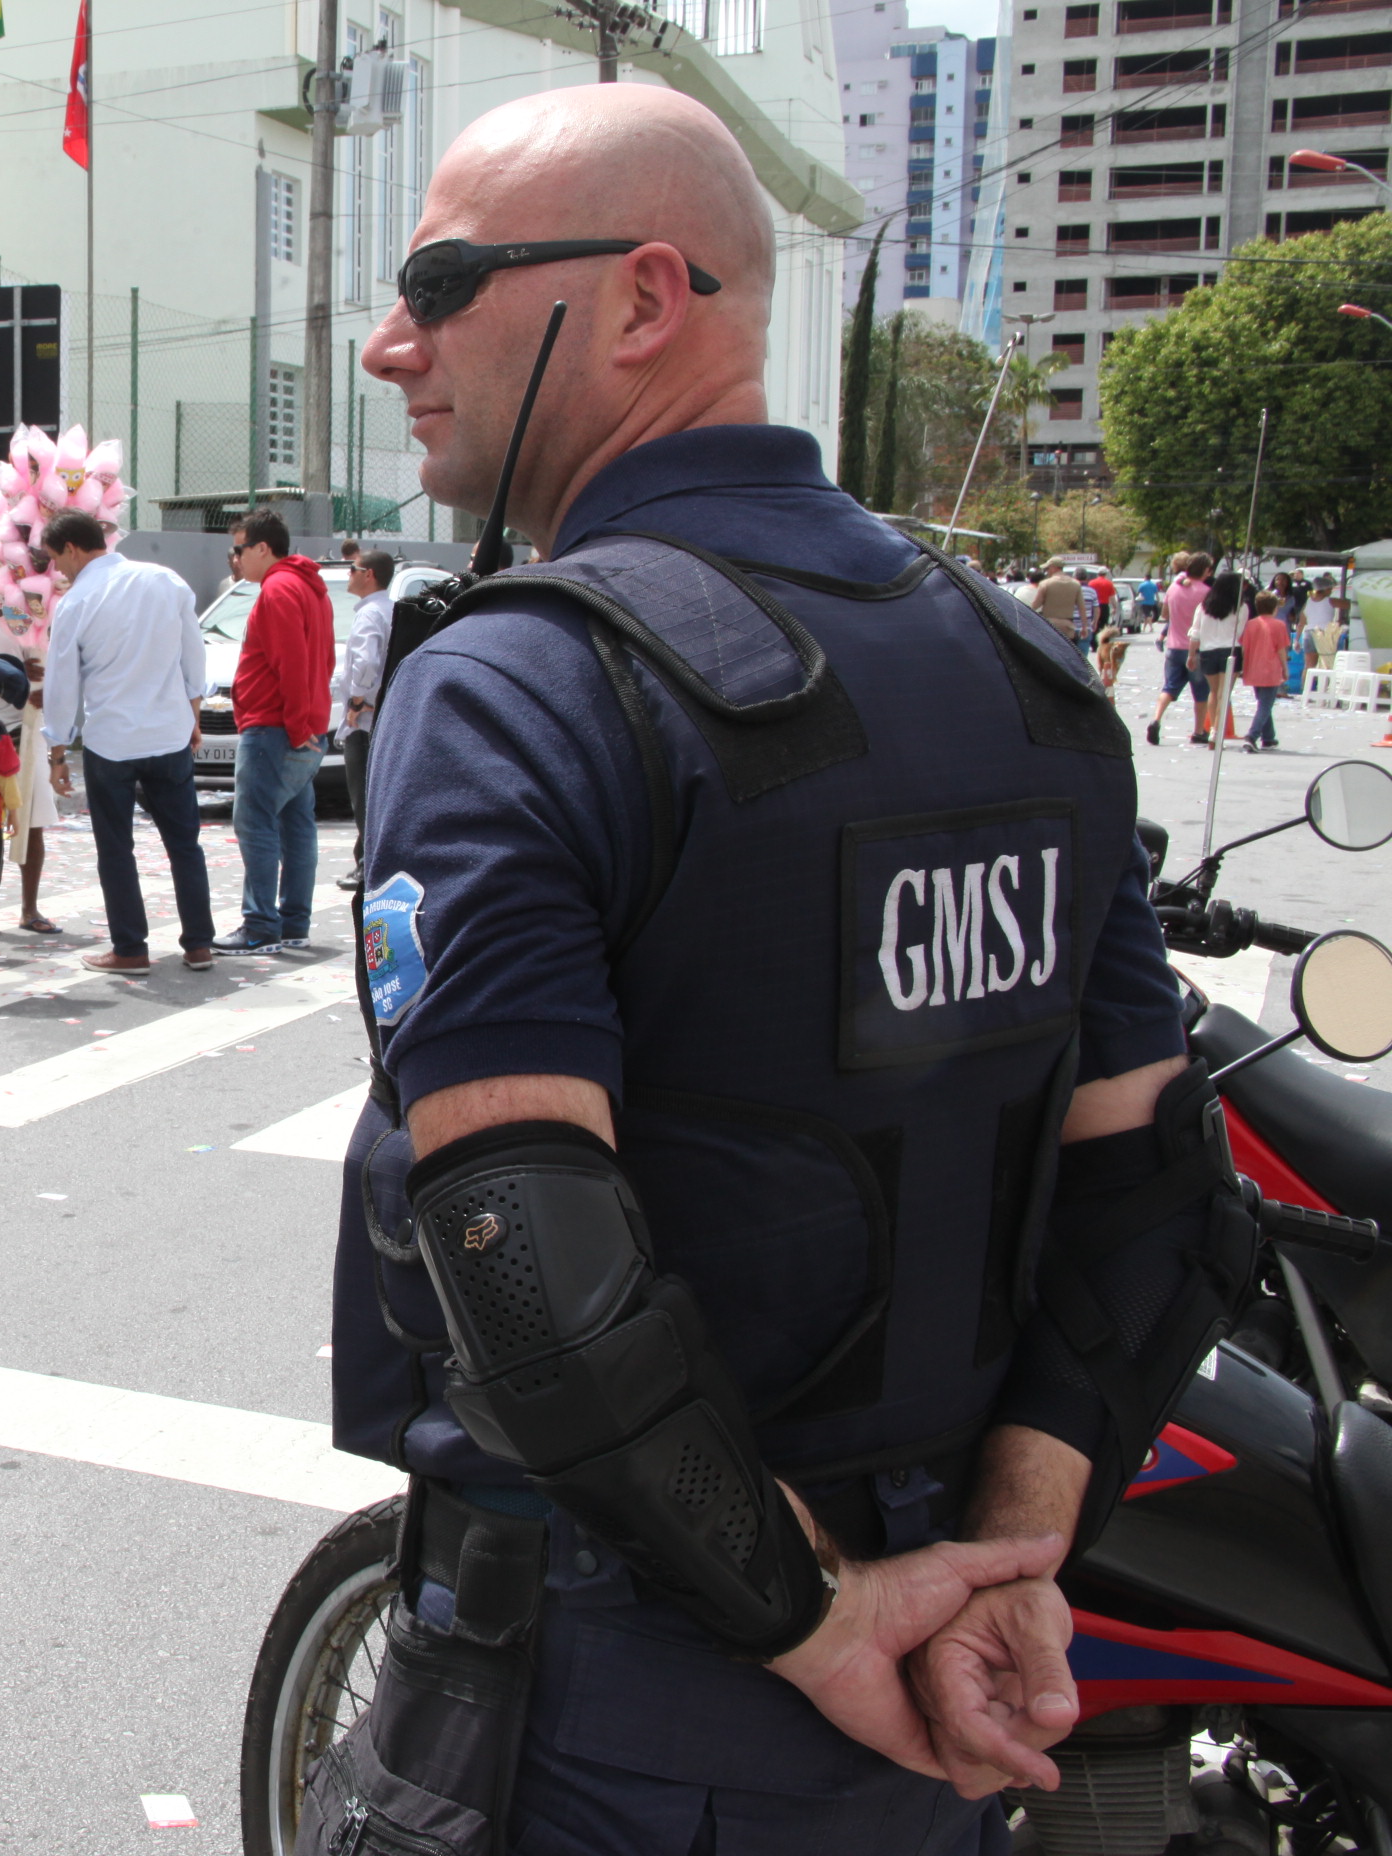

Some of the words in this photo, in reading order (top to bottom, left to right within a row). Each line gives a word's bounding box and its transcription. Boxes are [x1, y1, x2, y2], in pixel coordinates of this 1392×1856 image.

[370, 899, 410, 915] MUNICIPAL
[878, 847, 1059, 1011] GMSJ
[383, 975, 402, 997] JOSÉ
[382, 996, 393, 1013] SC
